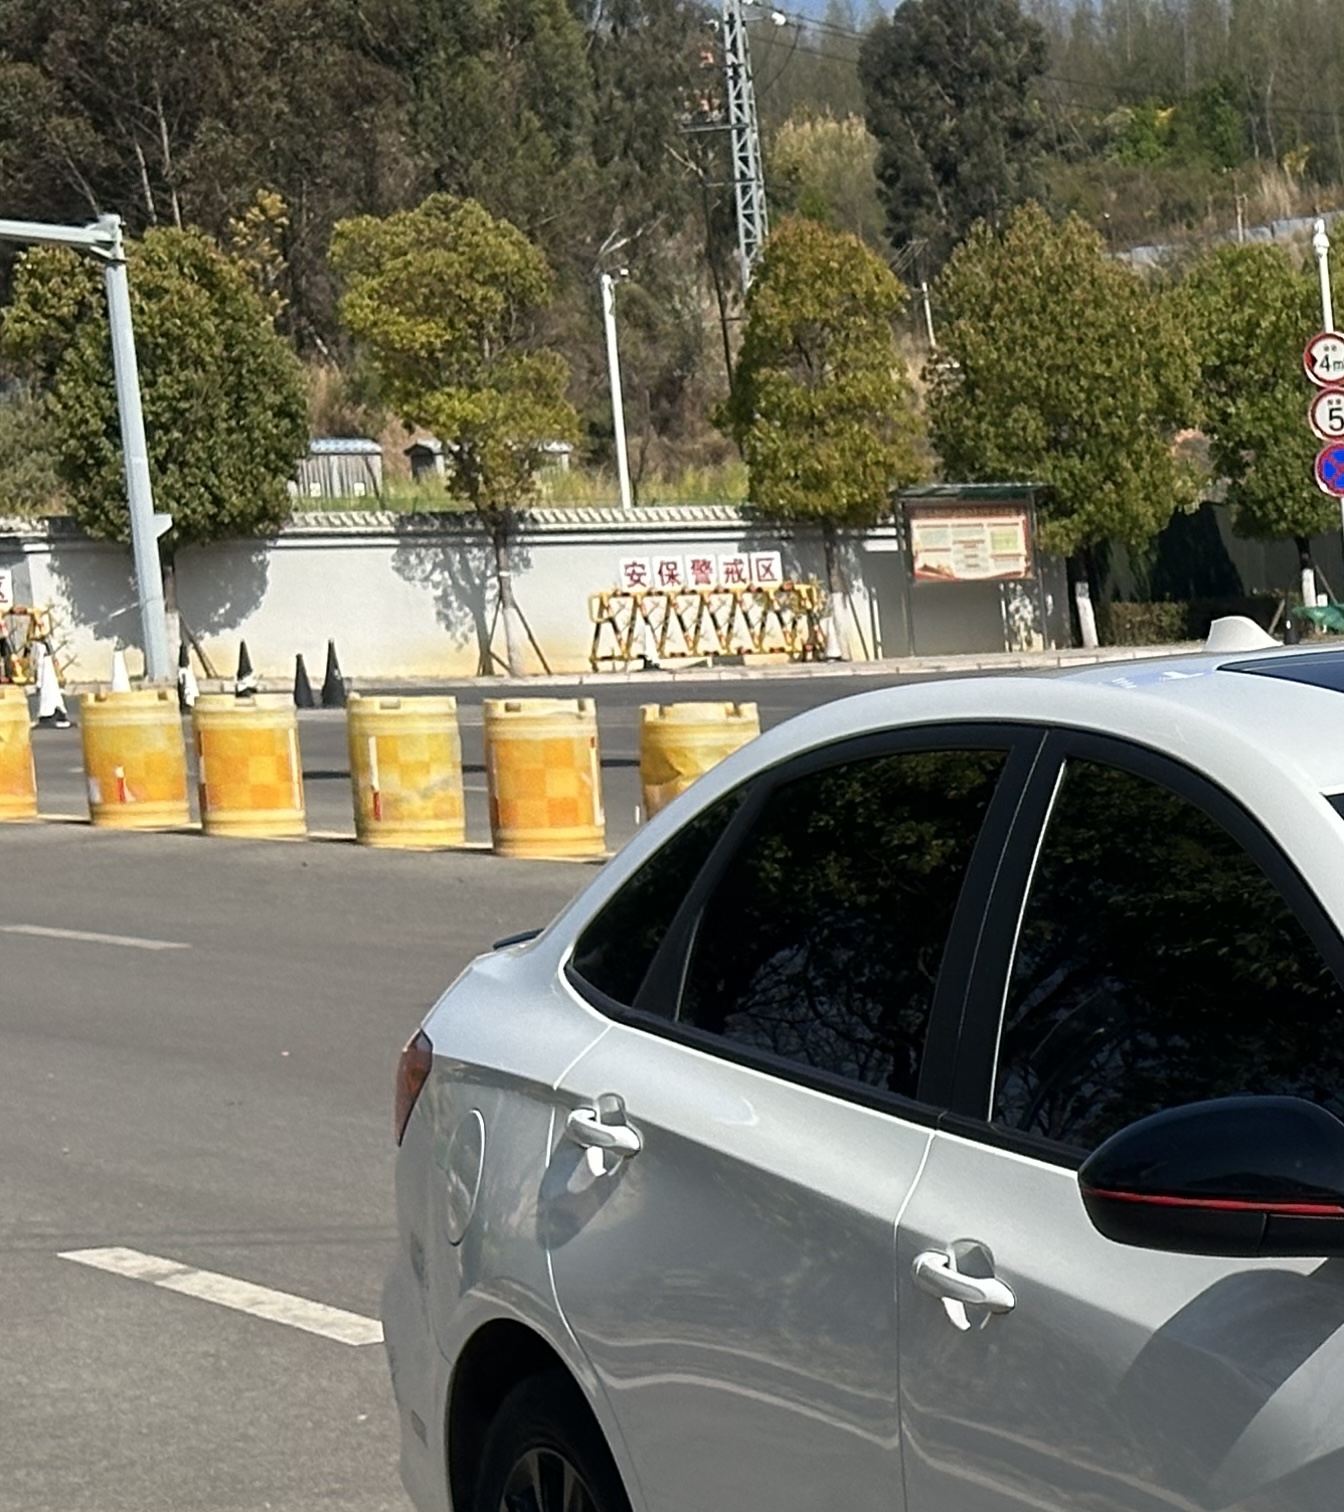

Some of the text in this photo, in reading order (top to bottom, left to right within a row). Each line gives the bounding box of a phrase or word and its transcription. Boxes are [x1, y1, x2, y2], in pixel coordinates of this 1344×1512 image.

[1319, 354, 1344, 372] 4m
[1328, 407, 1344, 432] 5
[623, 557, 778, 588] 安保警戒区
